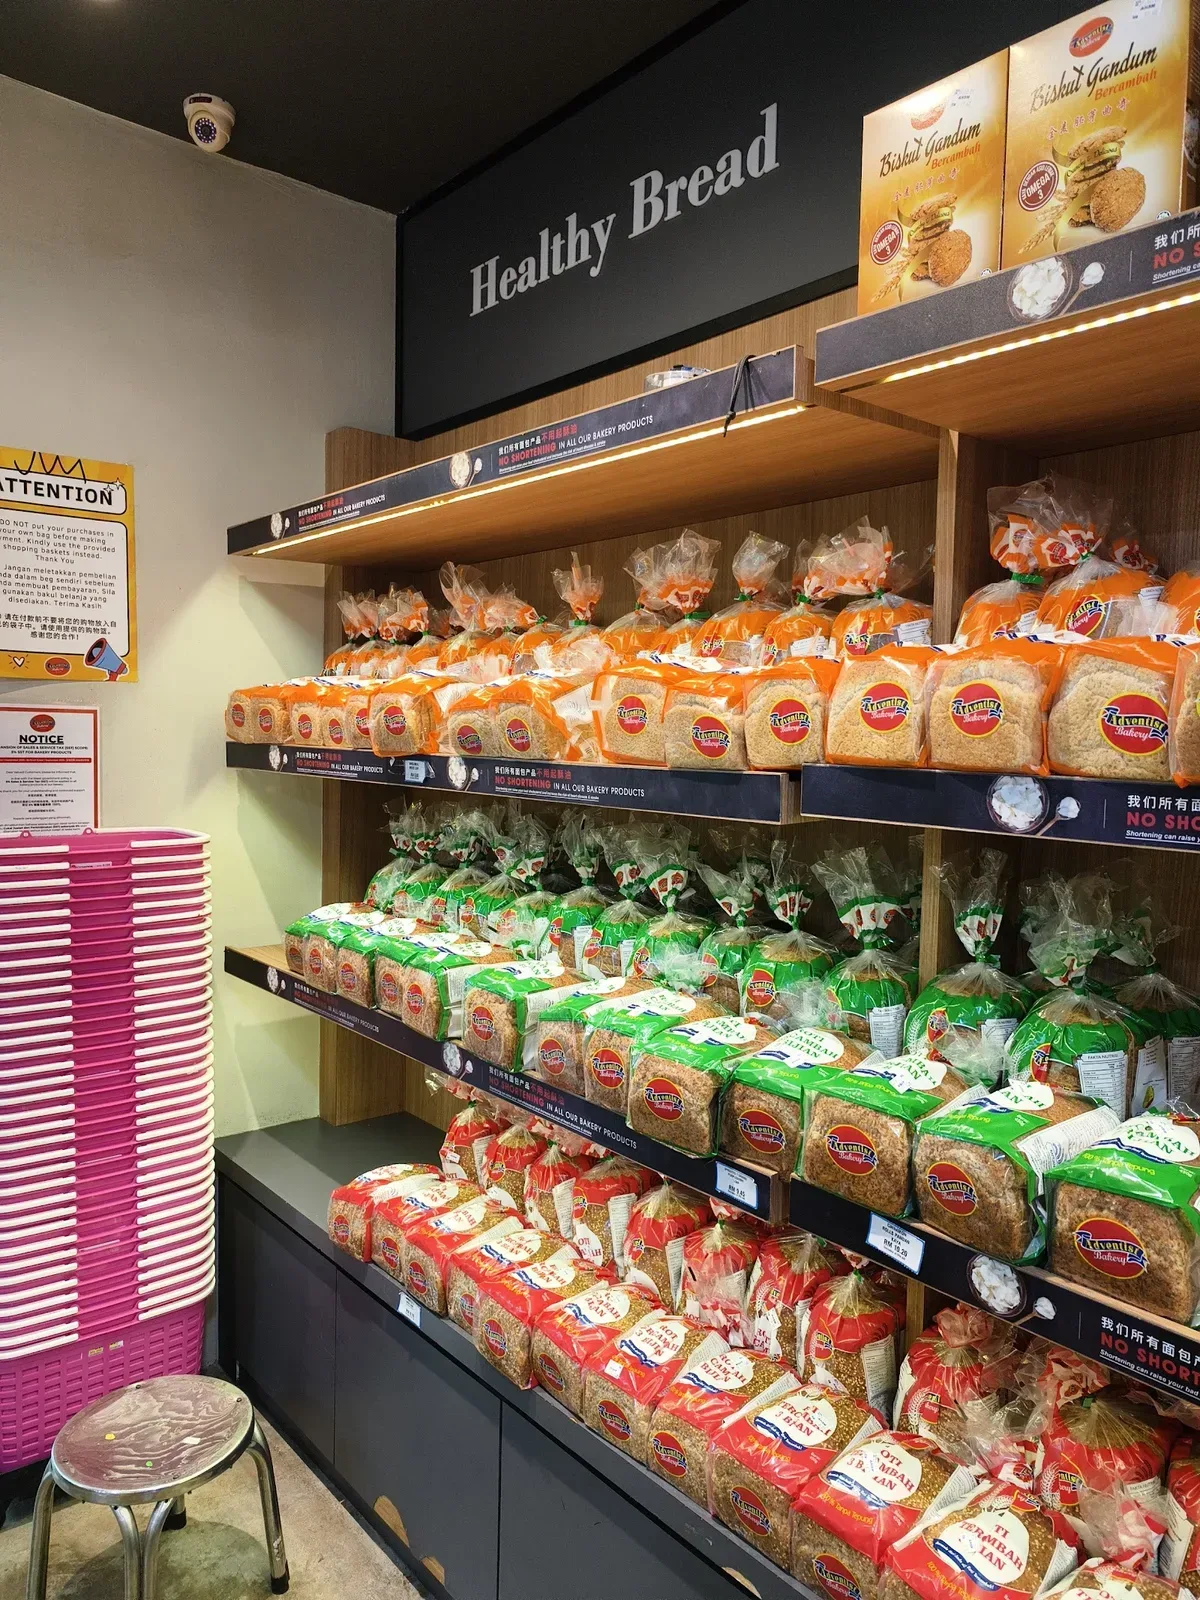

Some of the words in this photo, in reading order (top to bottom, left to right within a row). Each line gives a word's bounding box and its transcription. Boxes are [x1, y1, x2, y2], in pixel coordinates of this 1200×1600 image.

[1030, 65, 1084, 114] Biskut
[1086, 42, 1157, 97] Gandum
[1094, 66, 1157, 101] Bercambah
[879, 136, 923, 177] Biskut
[925, 118, 982, 166] Gandum
[931, 142, 981, 170] Bercambah
[1026, 173, 1051, 198] OMEGA
[1038, 189, 1044, 200] 3
[470, 212, 616, 317] Healthy
[628, 102, 780, 239] Bread
[876, 233, 897, 252] OMEGA
[886, 245, 891, 256] 3
[1153, 248, 1185, 269] NO
[1153, 264, 1192, 281] Shortening
[499, 456, 509, 466] NO
[512, 442, 556, 463] SHORTENING
[558, 440, 566, 450] IN
[566, 438, 577, 448] ALL
[578, 433, 592, 446] OUR
[593, 426, 617, 441] BAKERY
[618, 415, 654, 433] PRODUCTS
[366, 494, 386, 506] PRODUCTS
[14, 520, 29, 528] NOT
[67, 527, 104, 537] purchases
[27, 538, 50, 547] Kindly
[84, 544, 116, 553] provided
[36, 531, 50, 539] bag
[53, 533, 77, 541] before
[80, 536, 106, 545] making
[3, 544, 38, 554] shopping
[41, 548, 70, 556] baskets
[73, 551, 102, 559] instead.
[34, 568, 76, 577] meletakkan
[79, 572, 116, 580] pembelian
[15, 582, 49, 590] membuat
[52, 585, 99, 594] pembayaran.
[37, 590, 57, 598] bakul
[60, 593, 87, 601] belanja
[9, 597, 51, 606] disediakan.
[54, 600, 80, 608] Terima
[866, 700, 906, 712] Adventist
[958, 700, 999, 714] Adventist
[871, 711, 896, 720] Bakery
[963, 714, 989, 723] Bakery
[1110, 715, 1166, 731] Adventist
[20, 735, 64, 744] NOTICE
[1115, 727, 1149, 742] Bakery
[364, 766, 383, 774] PRODUCTS
[495, 776, 506, 785] NO
[507, 777, 551, 789] SHORTENING
[553, 782, 560, 790] IN
[561, 783, 571, 792] ALL
[573, 784, 585, 793] OUR
[587, 785, 609, 795] BAKERY
[610, 787, 645, 797] PRODUCTS
[1126, 812, 1156, 827] NO
[1126, 830, 1162, 840] Shortening
[489, 1076, 499, 1087] NO
[501, 1081, 545, 1106] SHORTENING
[546, 1102, 553, 1112] IN
[554, 1105, 564, 1117] ALL
[565, 1111, 578, 1123] OUR
[580, 1118, 602, 1134] BAKERY
[604, 1128, 637, 1150] PRODUCTS
[839, 1152, 864, 1164] Bakery
[884, 1239, 893, 1248] RM
[1086, 1240, 1139, 1254] Adventist
[1094, 1251, 1126, 1266] Bakery
[1100, 1332, 1129, 1355] NO
[1137, 1348, 1200, 1386] SHORT
[1100, 1349, 1135, 1370] Shortening
[1136, 1365, 1148, 1376] can
[1150, 1371, 1167, 1383] raise
[1168, 1379, 1184, 1390] your
[1185, 1386, 1199, 1397] bad
[880, 1449, 903, 1467] OTI
